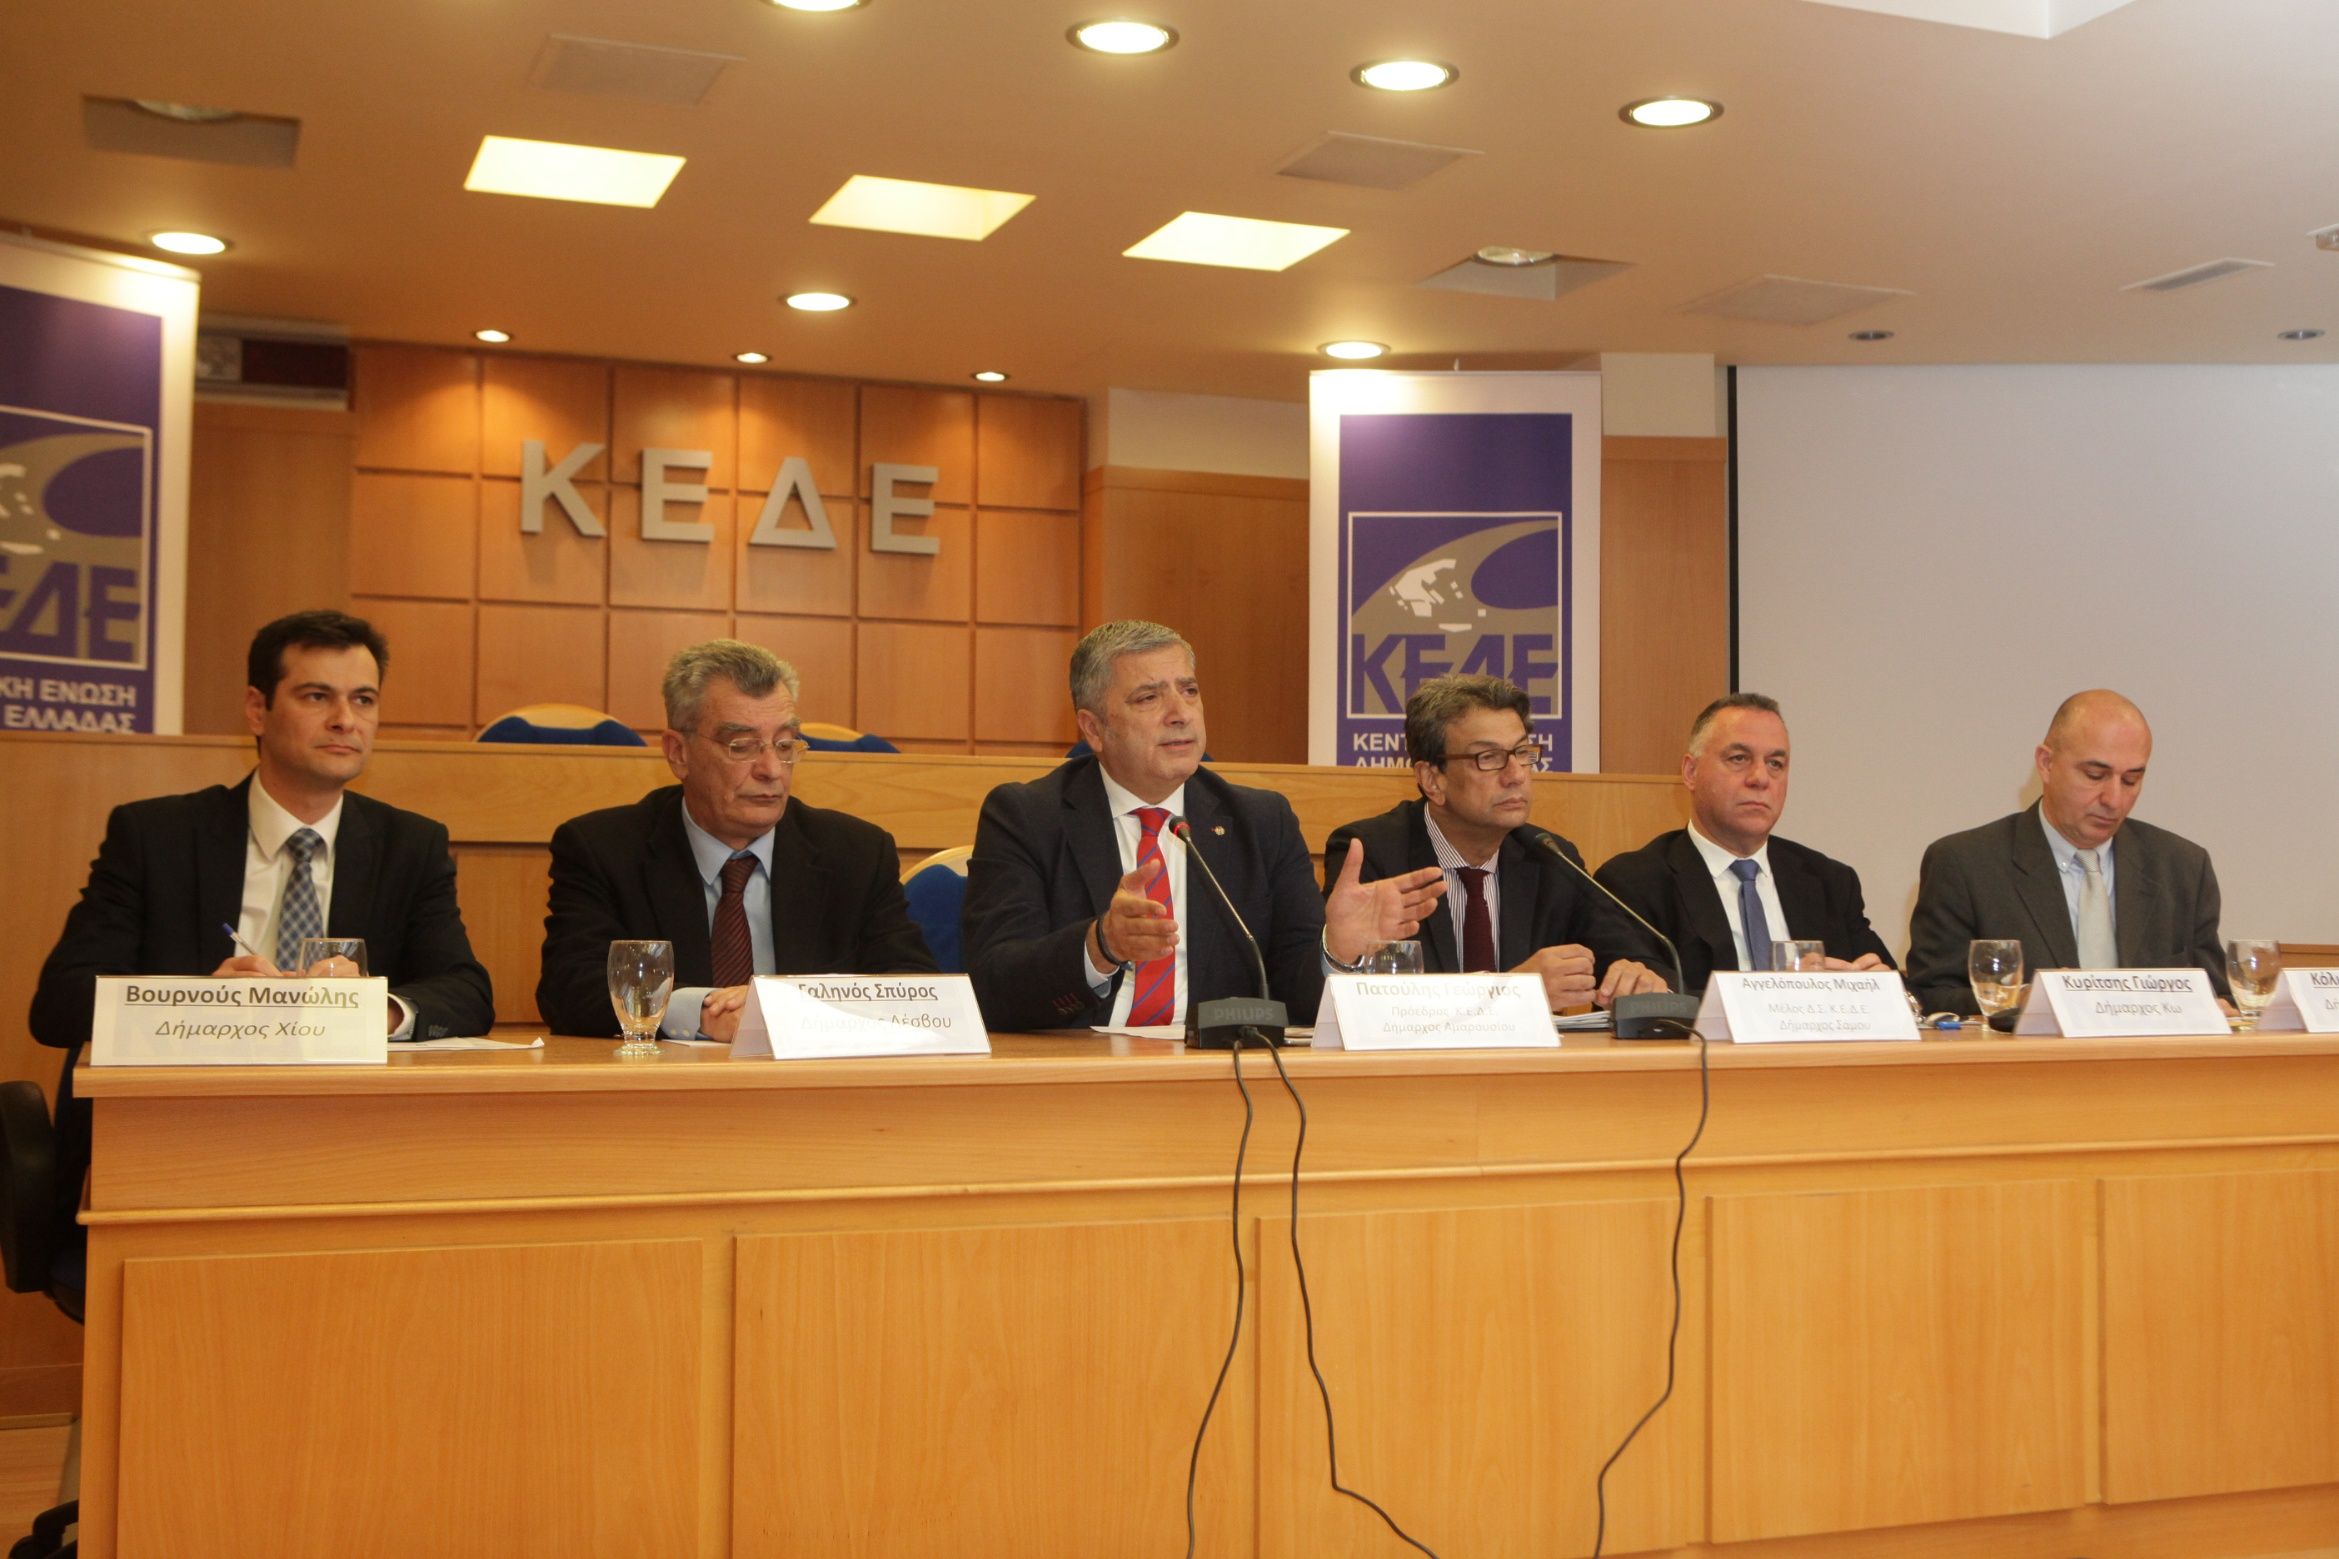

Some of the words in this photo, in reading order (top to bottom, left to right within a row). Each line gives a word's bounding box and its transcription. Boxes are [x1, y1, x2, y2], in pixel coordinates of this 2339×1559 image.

[521, 439, 940, 554] ΚΕΔΕ
[39, 679, 137, 708] ΕΝΩΣΗ
[4, 704, 136, 734] ΕΛΛΑΔΑΣ
[126, 985, 241, 1007] Βουρνούς
[249, 986, 359, 1008] Μανώλης
[874, 982, 938, 1001] Σπύρος
[1214, 1007, 1273, 1020] PHILIPS
[155, 1020, 269, 1039] Δήμαρχος
[275, 1021, 326, 1037] Χίου
